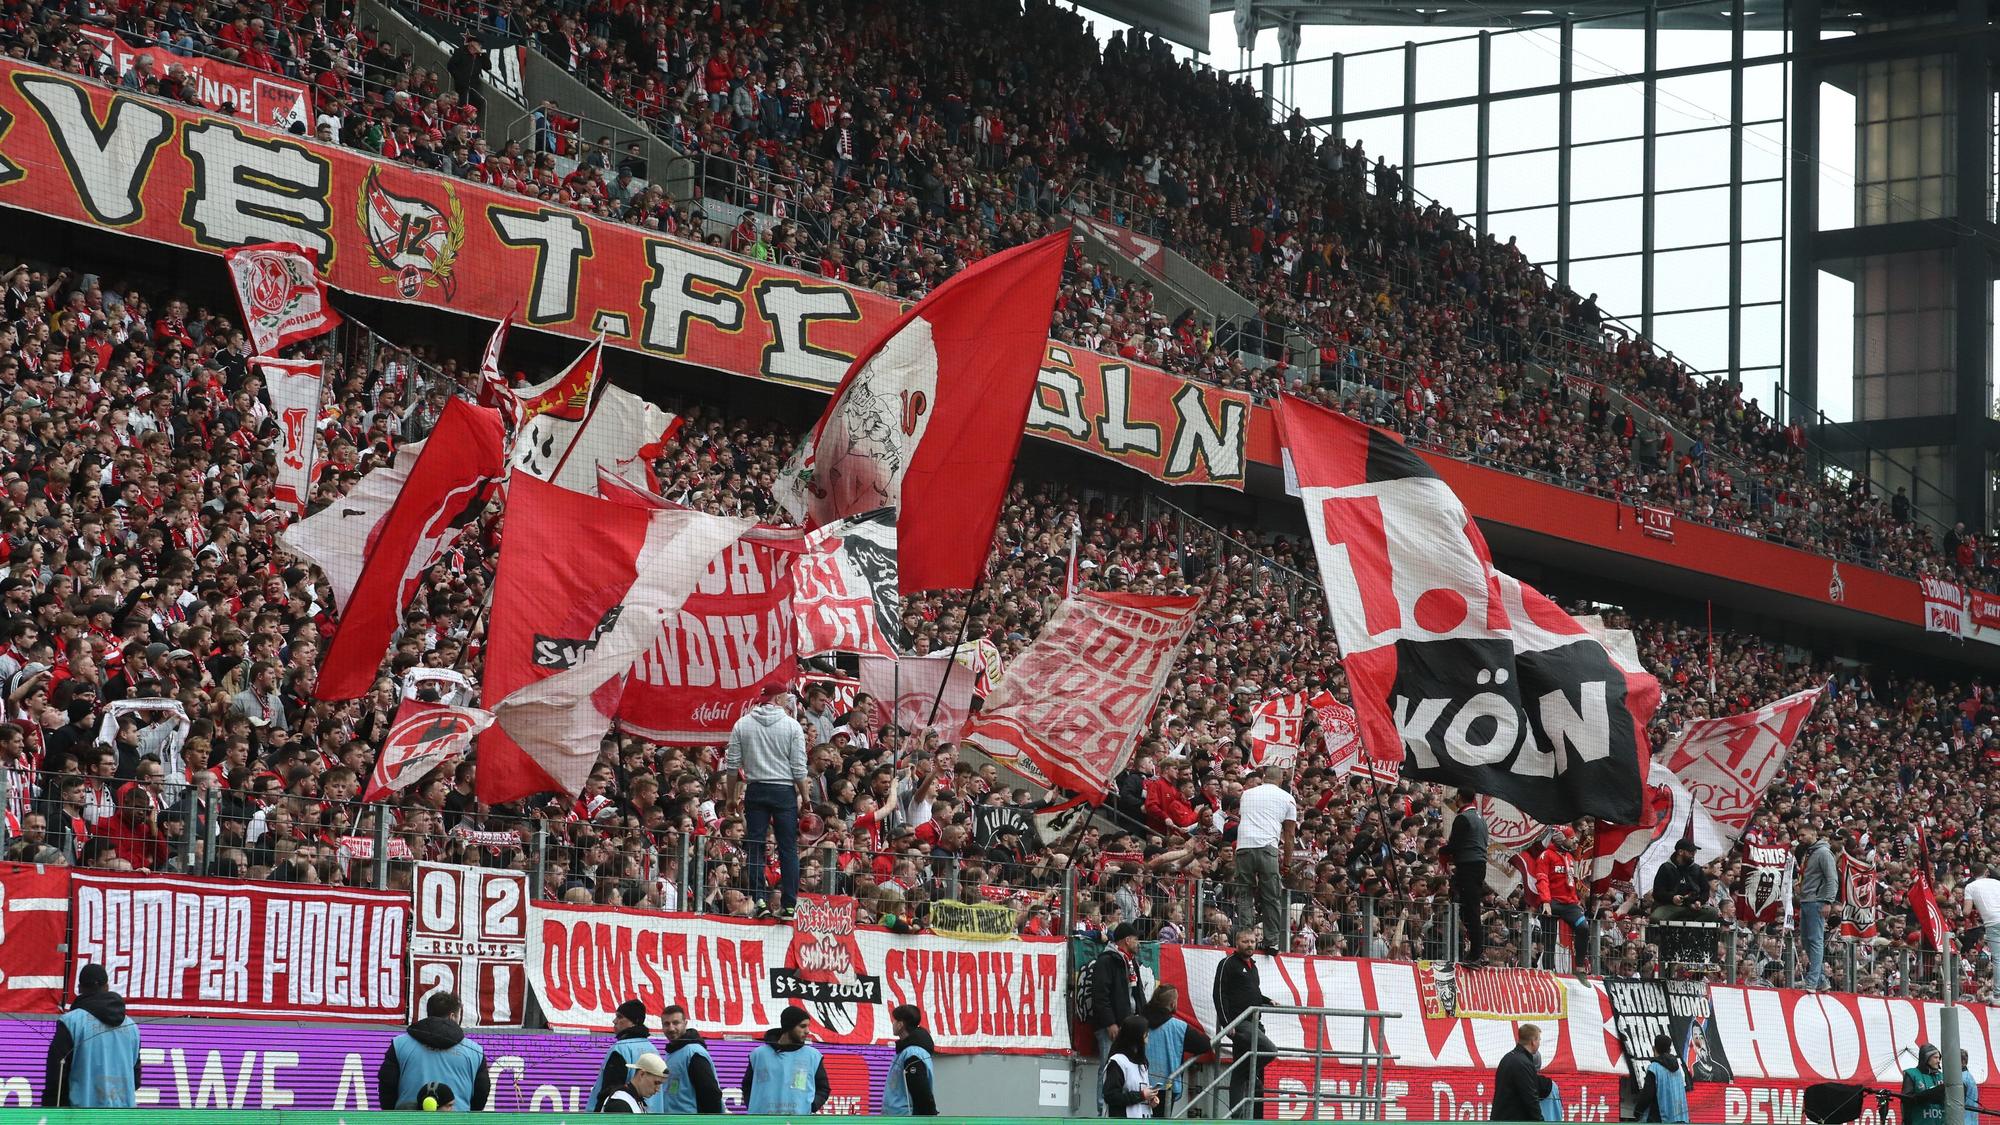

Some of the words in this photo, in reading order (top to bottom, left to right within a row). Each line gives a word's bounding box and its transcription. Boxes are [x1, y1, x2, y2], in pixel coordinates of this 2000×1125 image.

[0, 70, 334, 277] VE
[1026, 344, 1248, 482] ÖLN
[634, 594, 798, 690] NDIKAT
[76, 885, 251, 1000] SEMPER
[263, 898, 405, 1009] FIDELIS
[542, 919, 769, 1026] DOMSTADT
[886, 947, 1058, 1037] SYNDIKAT
[1455, 963, 1562, 1015] STADIONVERBOT
[1610, 981, 1668, 1014] SEKTION
[1669, 994, 1710, 1018] MOMO
[1711, 984, 2000, 1086] HORD
[136, 1048, 300, 1110] EWE
[1923, 1108, 1944, 1119] HOS
